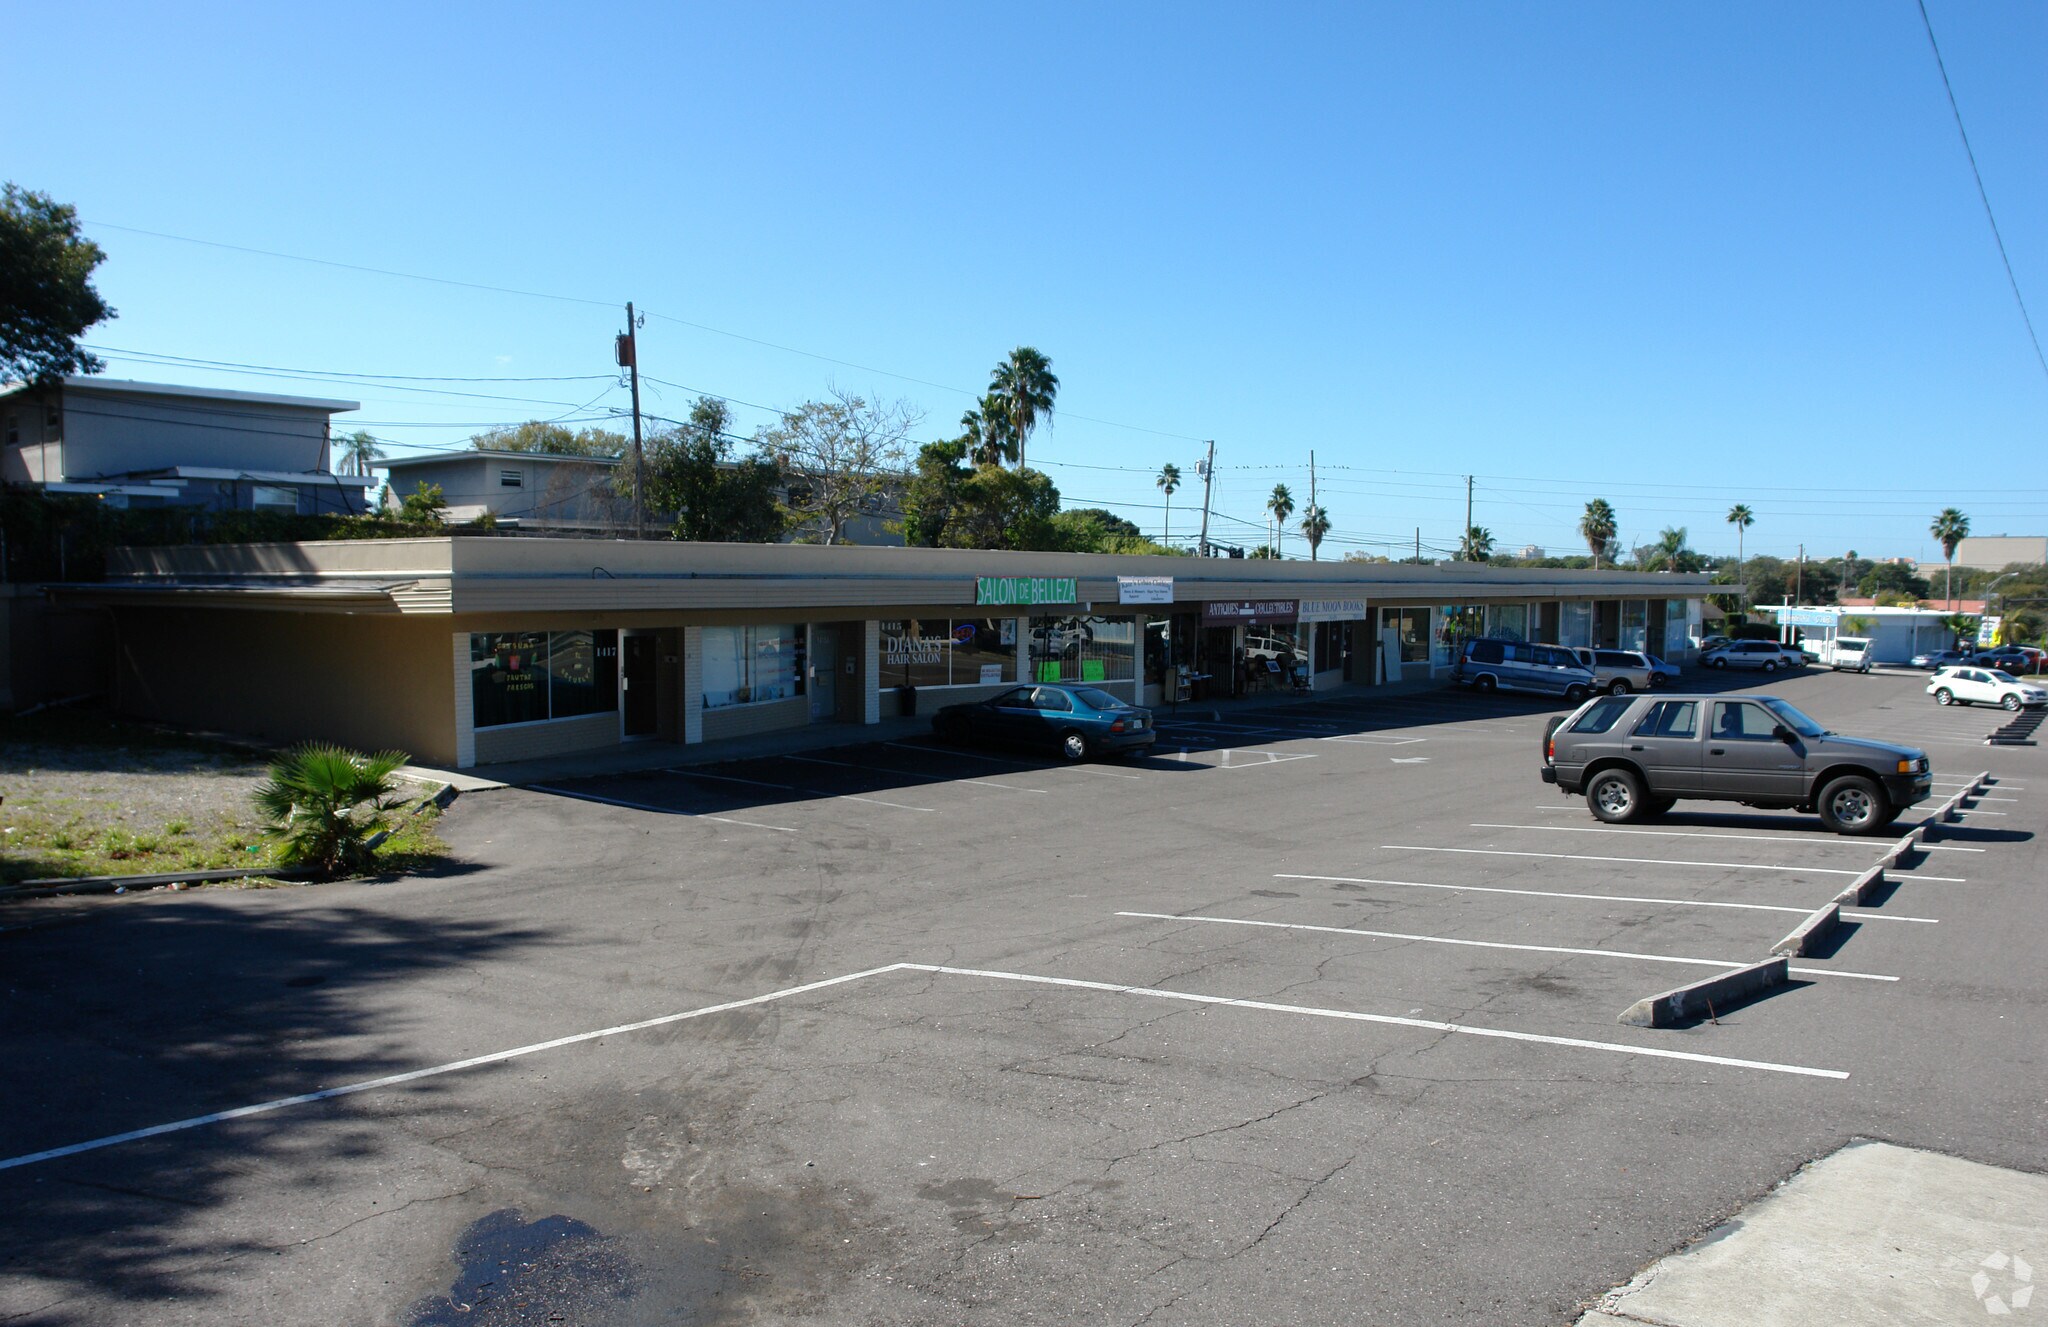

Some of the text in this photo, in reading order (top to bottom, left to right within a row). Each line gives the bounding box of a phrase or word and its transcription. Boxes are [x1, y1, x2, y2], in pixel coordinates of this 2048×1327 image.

[977, 577, 1077, 604] SALON DE BELLEZA
[1209, 602, 1294, 616] ANTIQUES COLLECTIBLES
[1303, 600, 1364, 613] BLUE MOON BOOKS
[887, 636, 941, 653] DIANA'S
[887, 652, 941, 665] HAIR SALON
